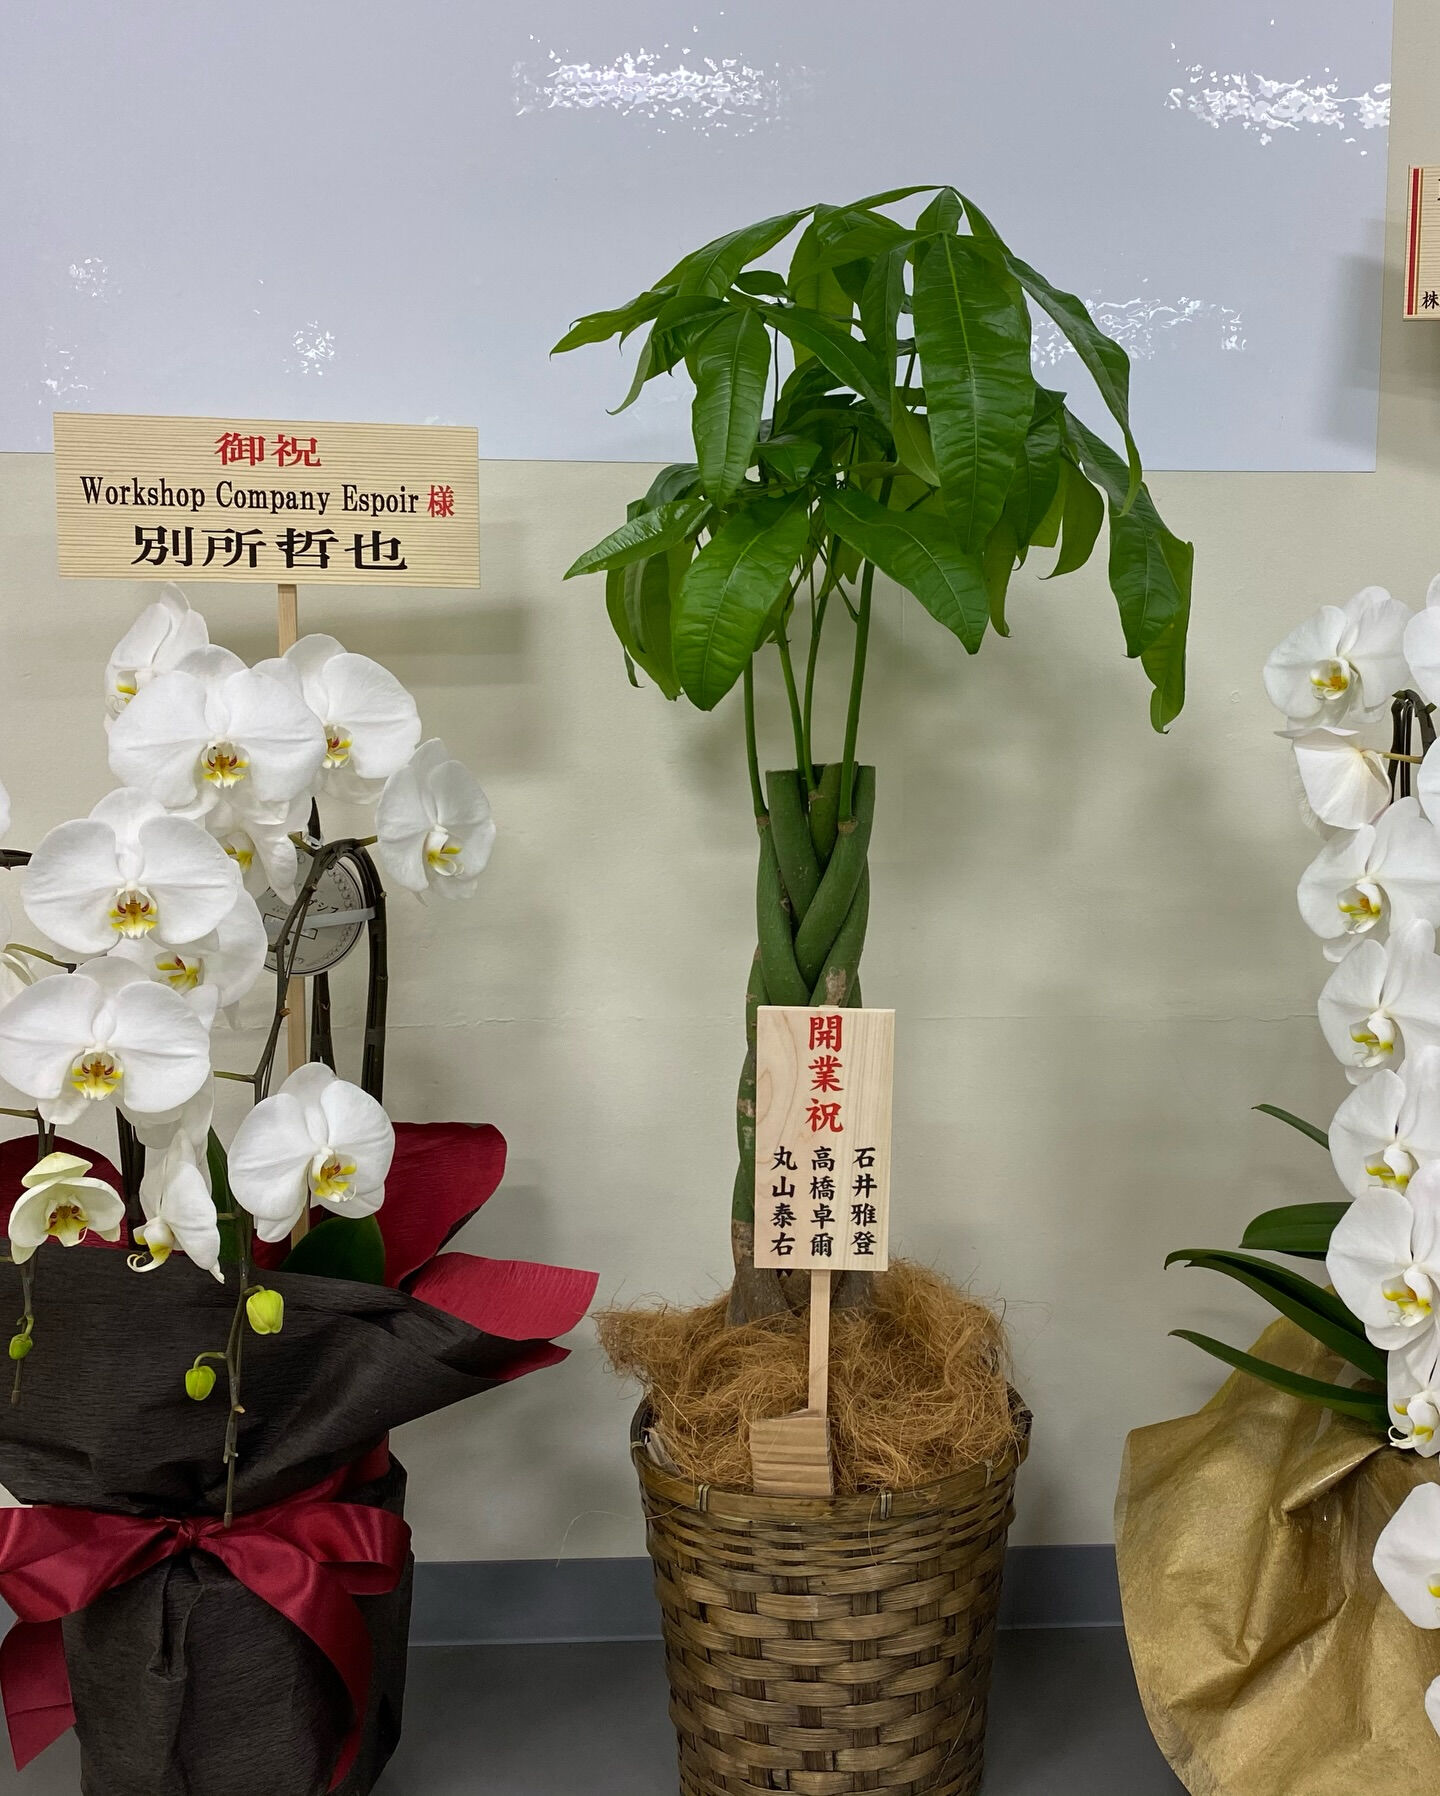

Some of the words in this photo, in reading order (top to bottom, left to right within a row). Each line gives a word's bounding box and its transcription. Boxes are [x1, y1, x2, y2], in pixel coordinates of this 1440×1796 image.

[79, 475, 206, 513] Workshop
[216, 480, 331, 516] Company
[341, 484, 419, 518] Espoir
[427, 484, 455, 518] 様
[214, 431, 322, 467] 御祝
[130, 525, 408, 571] 別所哲也
[804, 1014, 844, 1133] 開業祝
[770, 1145, 798, 1257] 丸山泰右
[808, 1145, 836, 1258] 高橋卓爾
[850, 1146, 878, 1256] 石井雅登
